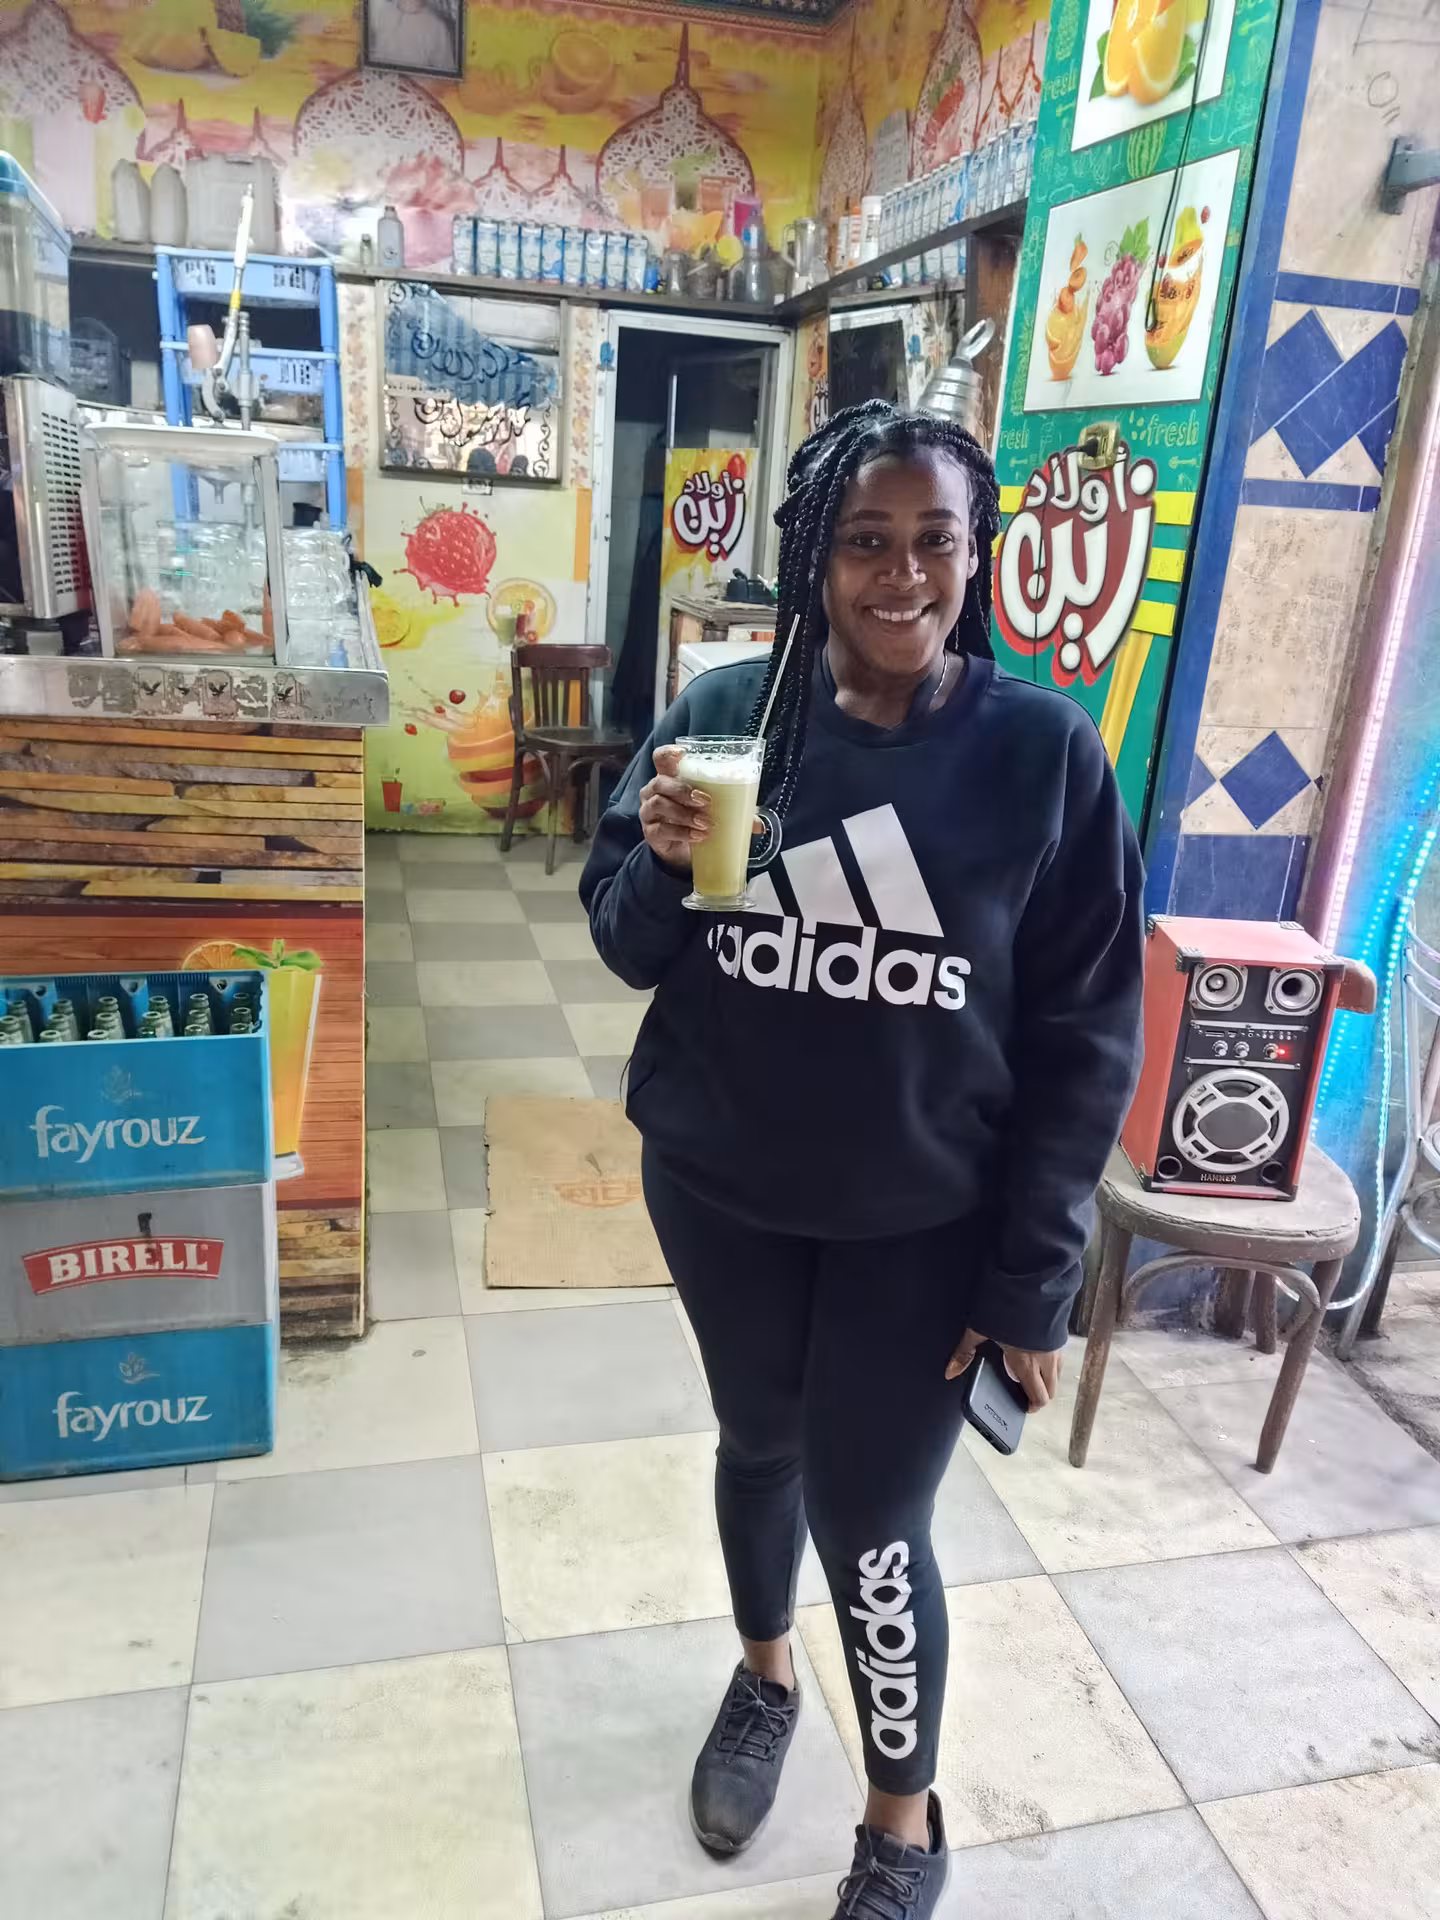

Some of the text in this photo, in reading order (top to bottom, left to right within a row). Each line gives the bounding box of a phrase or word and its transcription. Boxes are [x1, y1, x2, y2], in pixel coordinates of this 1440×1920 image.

[1147, 409, 1199, 447] fresh
[673, 478, 745, 555] زين
[1000, 463, 1154, 669] زين
[707, 916, 971, 1010] adidas
[29, 1104, 207, 1163] fayrouz
[48, 1242, 209, 1285] BIRELL
[52, 1391, 213, 1442] fayrouz
[849, 1540, 919, 1760] adidas
